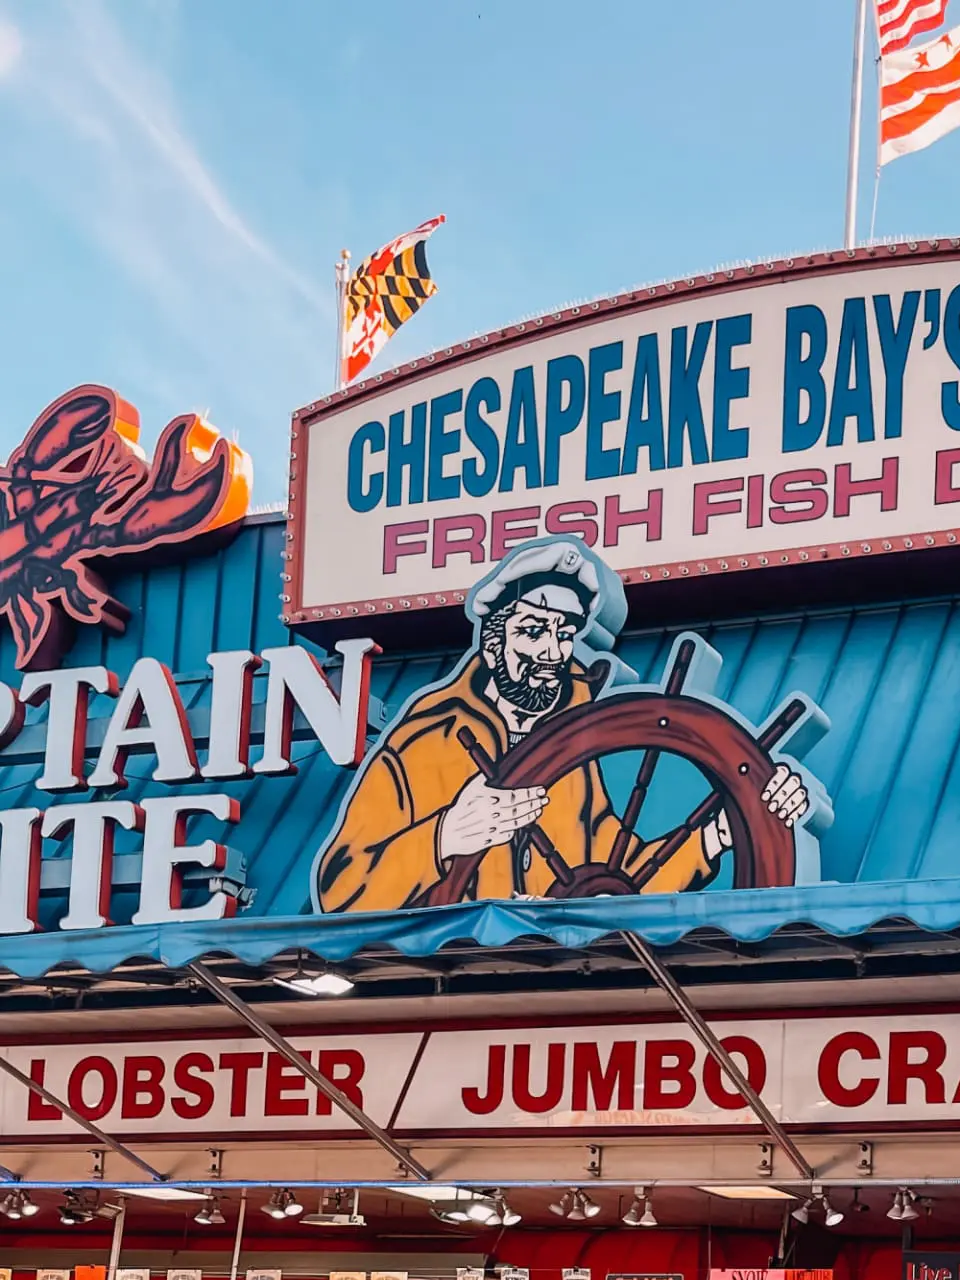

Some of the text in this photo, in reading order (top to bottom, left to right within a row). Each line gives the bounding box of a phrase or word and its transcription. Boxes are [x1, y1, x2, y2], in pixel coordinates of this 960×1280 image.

[346, 313, 753, 515] CHESAPEAKE
[383, 488, 664, 575] FRESH
[692, 456, 900, 537] FISH
[0, 638, 378, 791] TAIN
[27, 1048, 366, 1122] LOBSTER
[461, 1034, 767, 1115] JUMBO
